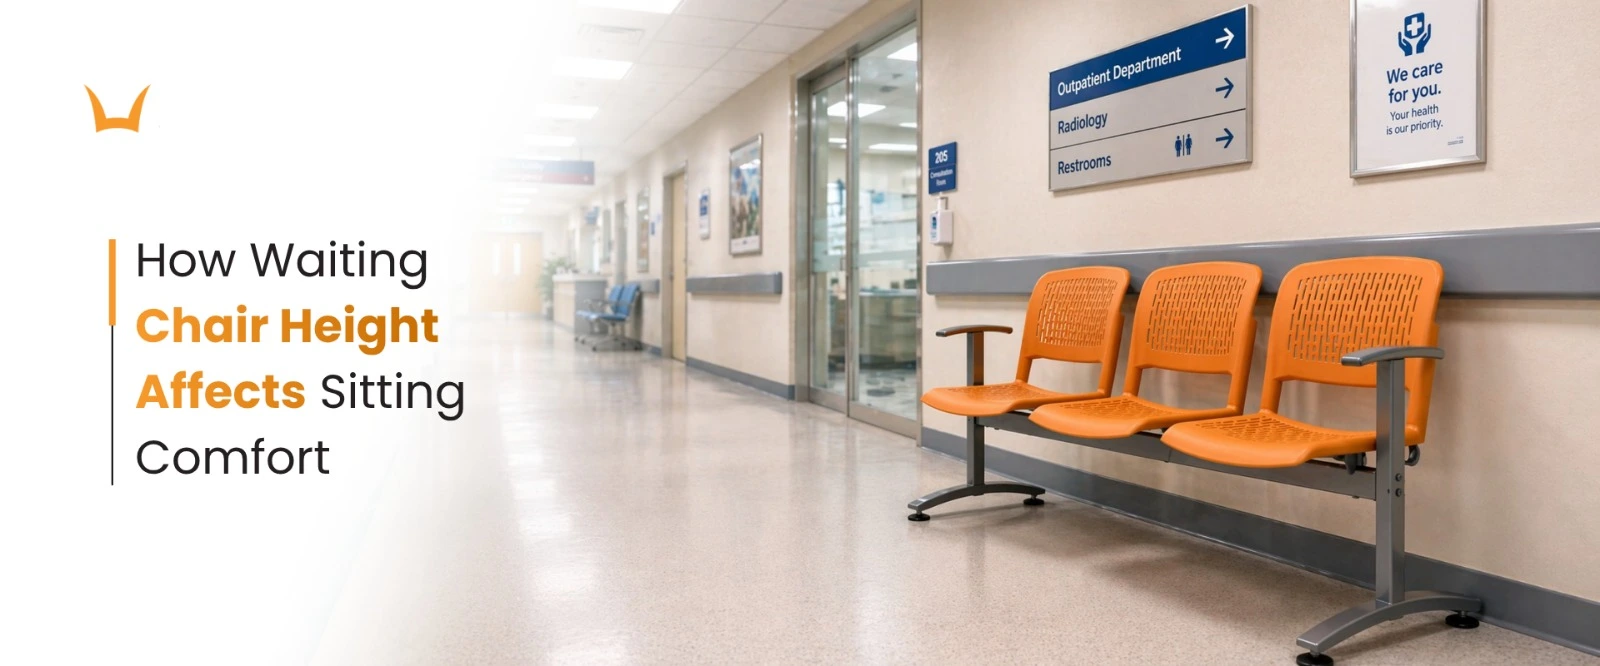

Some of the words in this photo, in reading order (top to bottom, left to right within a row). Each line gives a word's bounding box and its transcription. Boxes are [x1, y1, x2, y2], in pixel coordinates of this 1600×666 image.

[1057, 69, 1111, 96] Outpatient
[1113, 46, 1182, 80] Department
[1386, 67, 1409, 84] We
[1411, 62, 1443, 79] care
[1388, 88, 1409, 104] for
[1411, 83, 1441, 103] you.
[1389, 111, 1410, 121] Your
[1411, 104, 1439, 118] health
[1057, 113, 1108, 134] Radiology
[1386, 126, 1393, 135] is
[1394, 125, 1408, 134] our
[1410, 118, 1444, 133] priority.
[934, 149, 949, 164] 205
[1057, 155, 1112, 175] Restrooms
